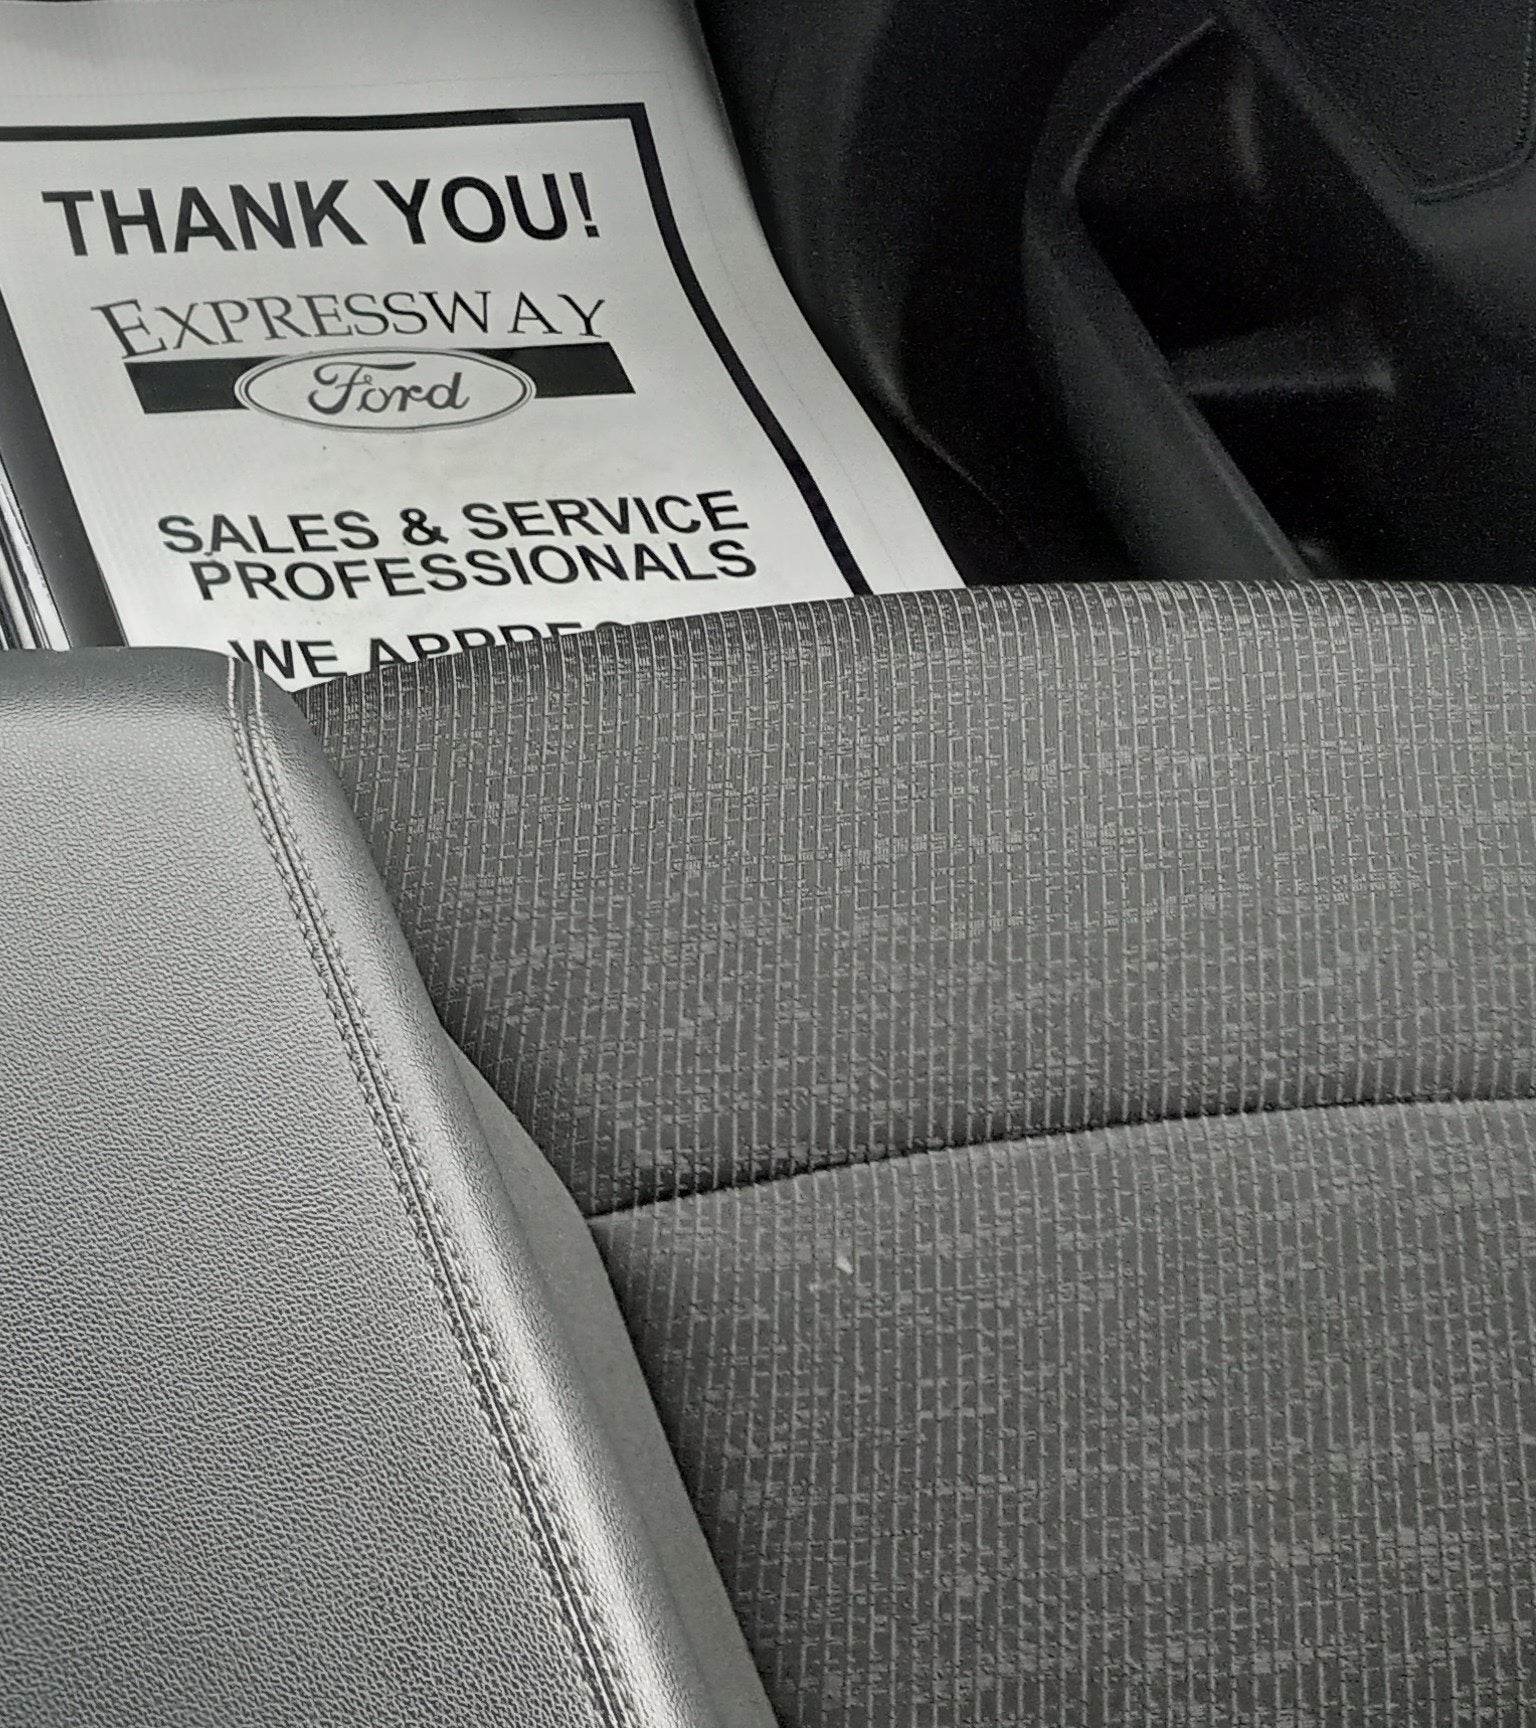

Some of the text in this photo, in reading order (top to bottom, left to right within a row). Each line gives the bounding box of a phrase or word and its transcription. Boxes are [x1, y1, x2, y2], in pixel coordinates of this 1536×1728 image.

[41, 171, 601, 258] THANK YOU!
[91, 289, 608, 358] EXPRESSWAY
[307, 361, 470, 417] Ford
[158, 489, 750, 555] SALES & SERVICE
[188, 540, 758, 603] PROFESSIONALS
[228, 638, 348, 679] WE
